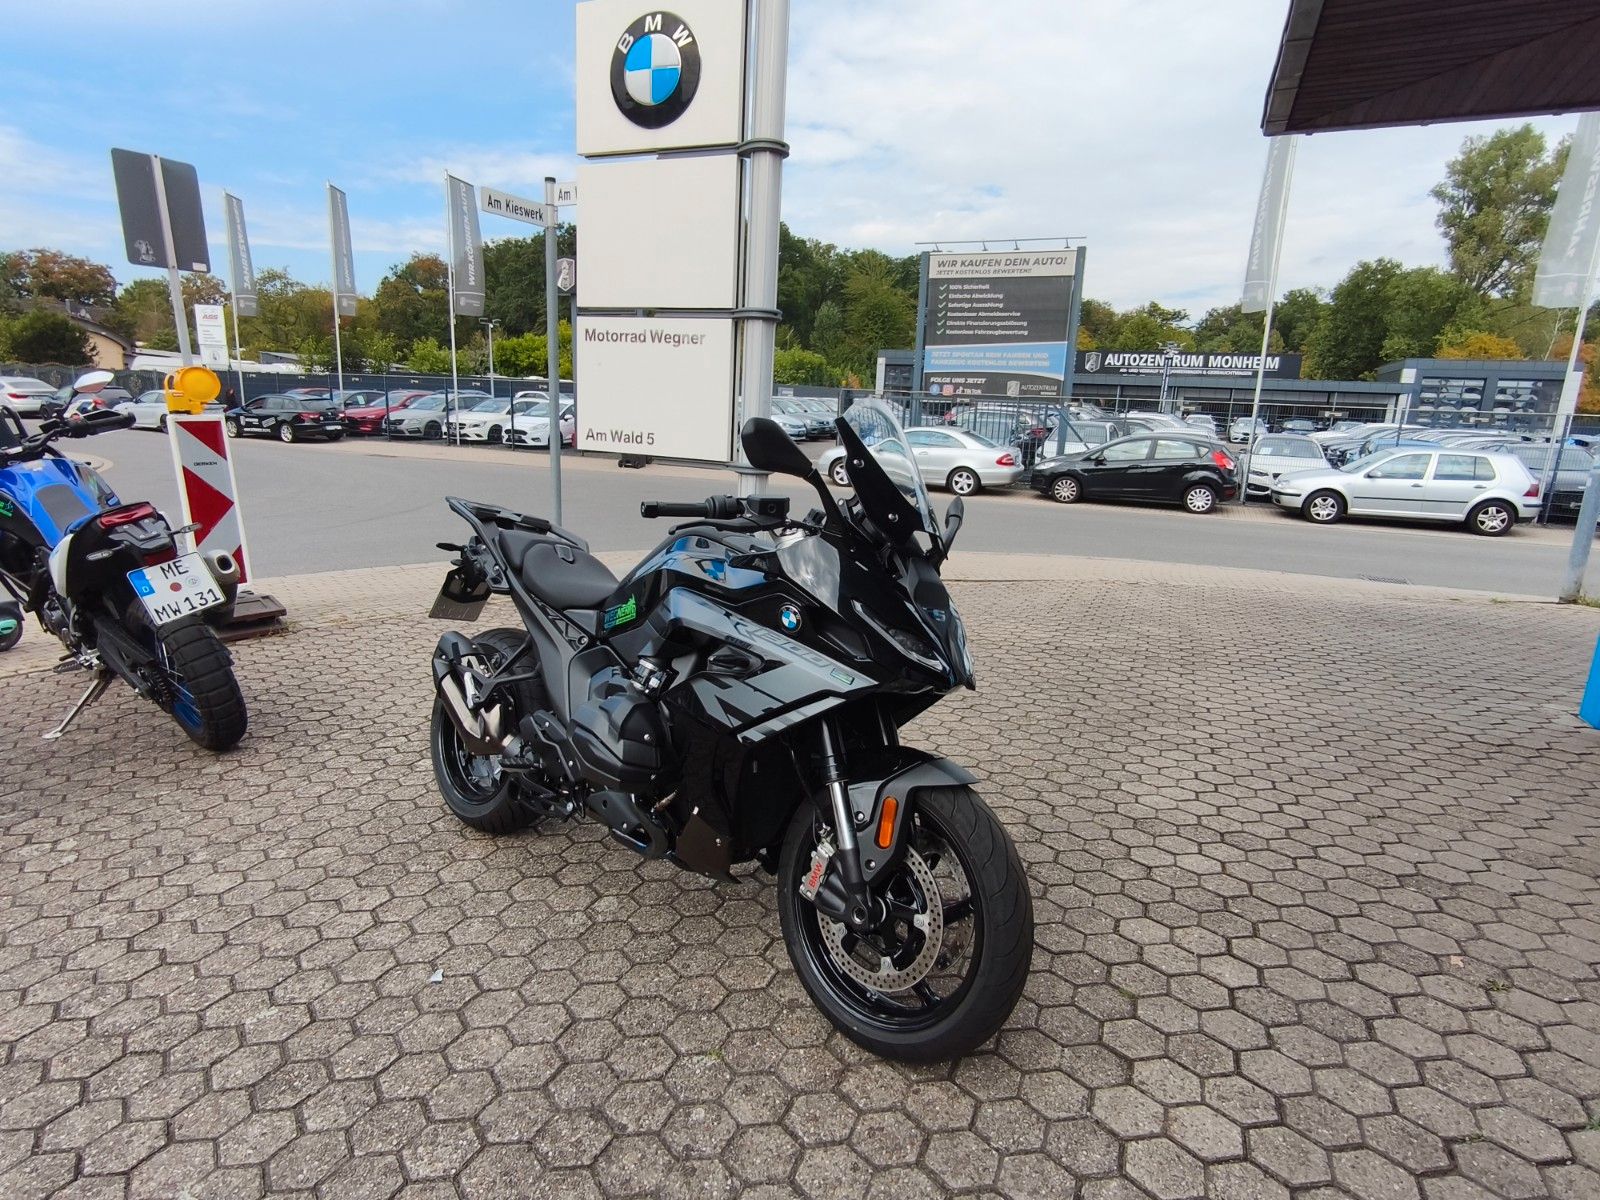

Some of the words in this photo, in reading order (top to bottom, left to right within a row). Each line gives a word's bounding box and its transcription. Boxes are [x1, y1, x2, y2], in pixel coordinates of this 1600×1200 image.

[617, 13, 693, 54] BMW
[558, 187, 571, 201] Am
[487, 194, 502, 211] Am
[505, 198, 544, 222] Kieswerk
[937, 260, 957, 268] WIR
[960, 258, 1002, 268] KAUFEN
[1004, 257, 1031, 267] DEIN
[1032, 256, 1068, 266] AUTO!
[972, 292, 1004, 300] Abwicklung
[584, 328, 646, 343] Motorrad
[650, 329, 706, 347] Wegner
[1208, 354, 1280, 370] MONHEM
[585, 428, 607, 442] Am
[610, 429, 643, 445] Wald
[646, 432, 655, 445] 5
[160, 559, 189, 580] ME
[142, 585, 150, 593] D
[154, 601, 182, 622] MW
[184, 588, 220, 612] 131
[808, 862, 823, 888] BMW
